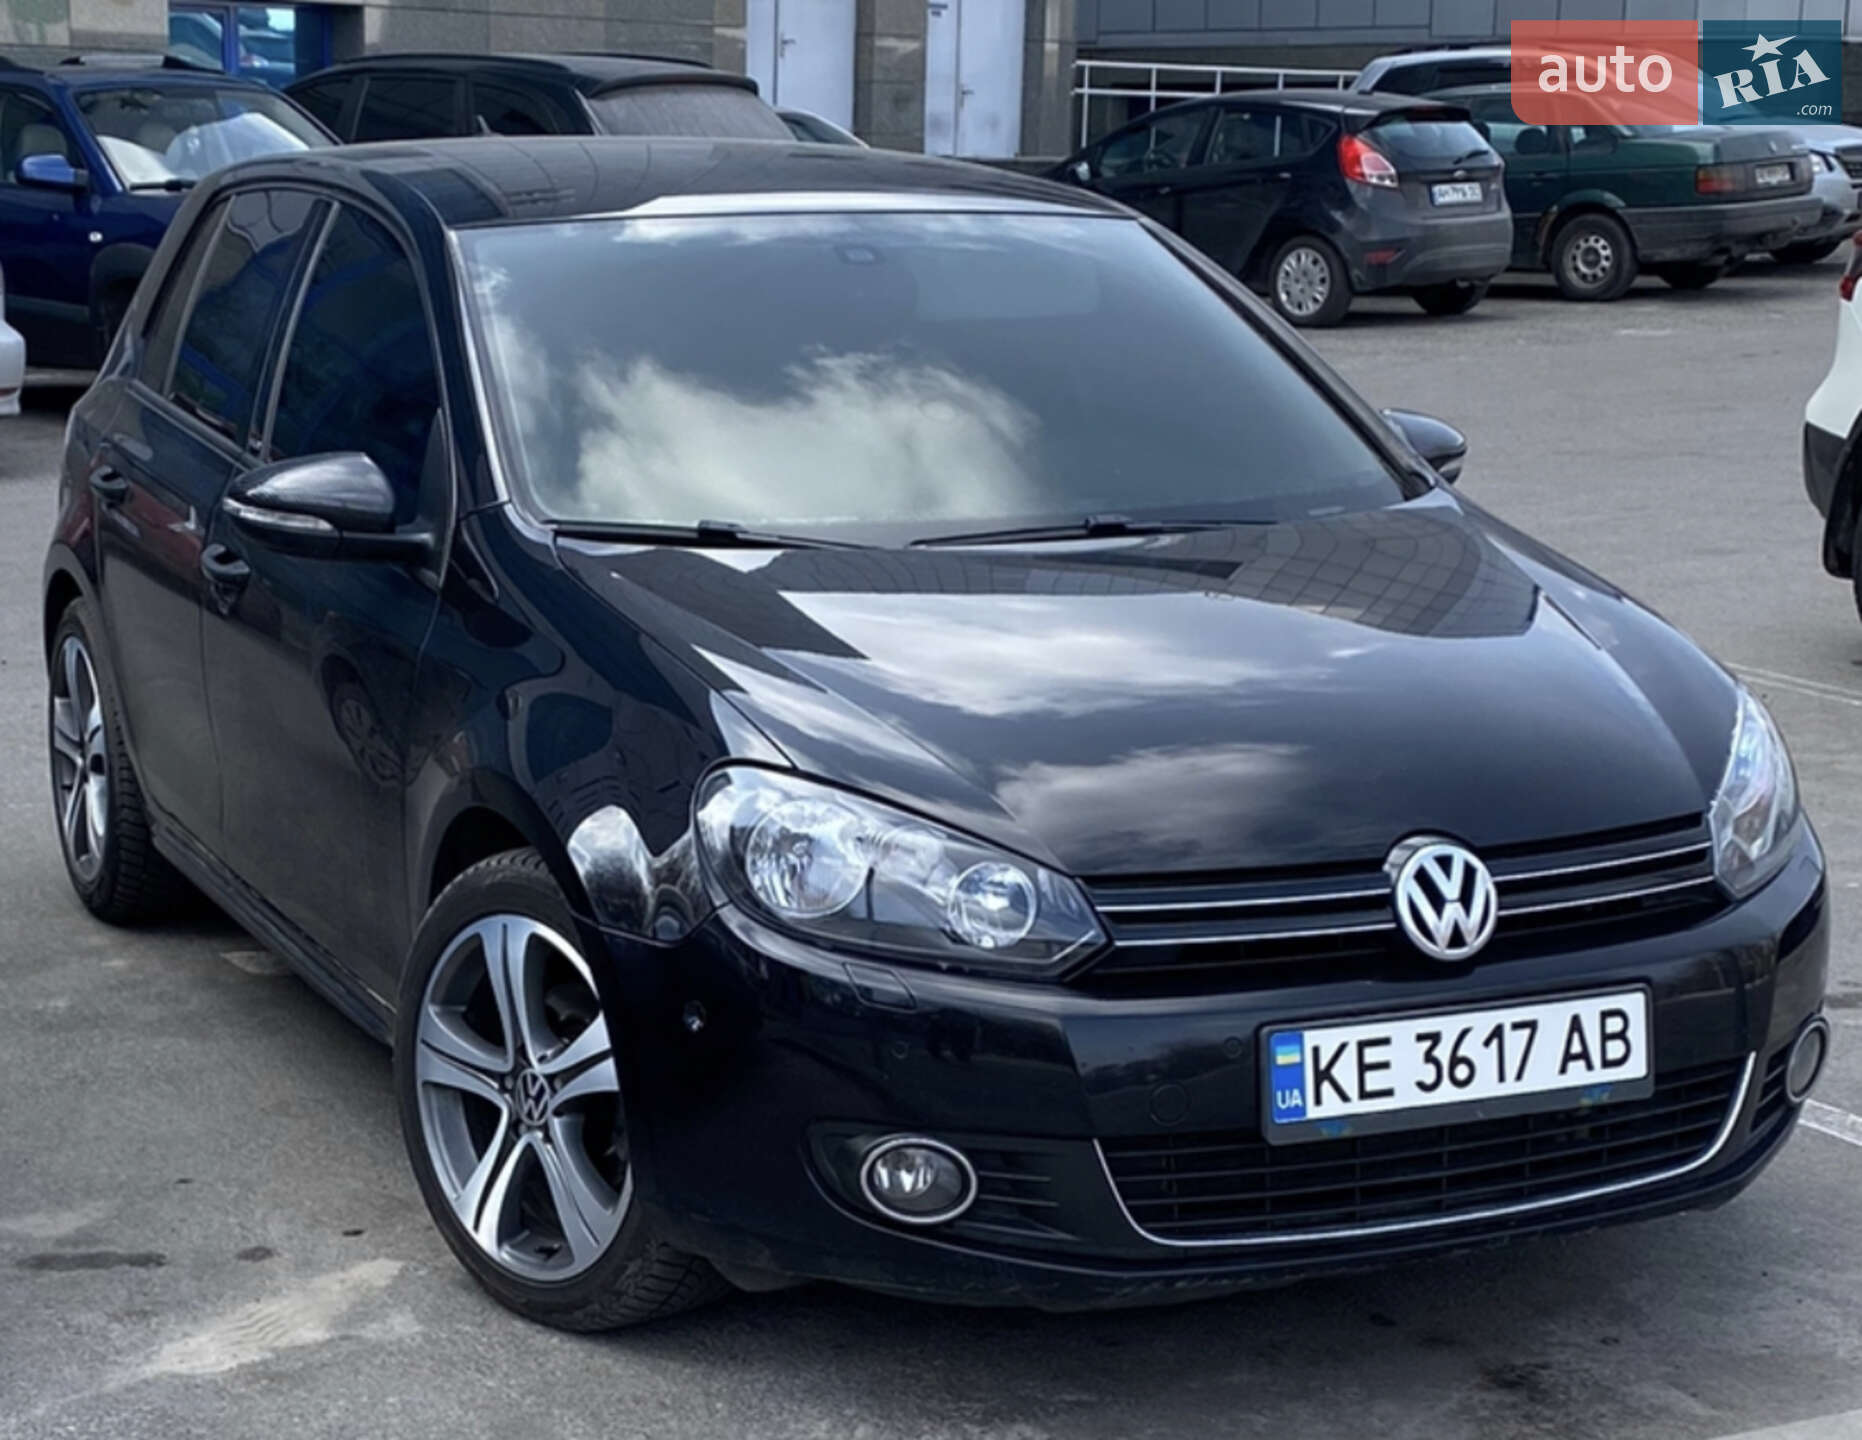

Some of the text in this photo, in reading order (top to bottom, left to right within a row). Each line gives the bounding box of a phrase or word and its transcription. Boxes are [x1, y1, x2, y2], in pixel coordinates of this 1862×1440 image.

[1398, 845, 1496, 959] VW
[1277, 1088, 1302, 1108] UA
[1312, 1008, 1632, 1107] KE 3617 AB
